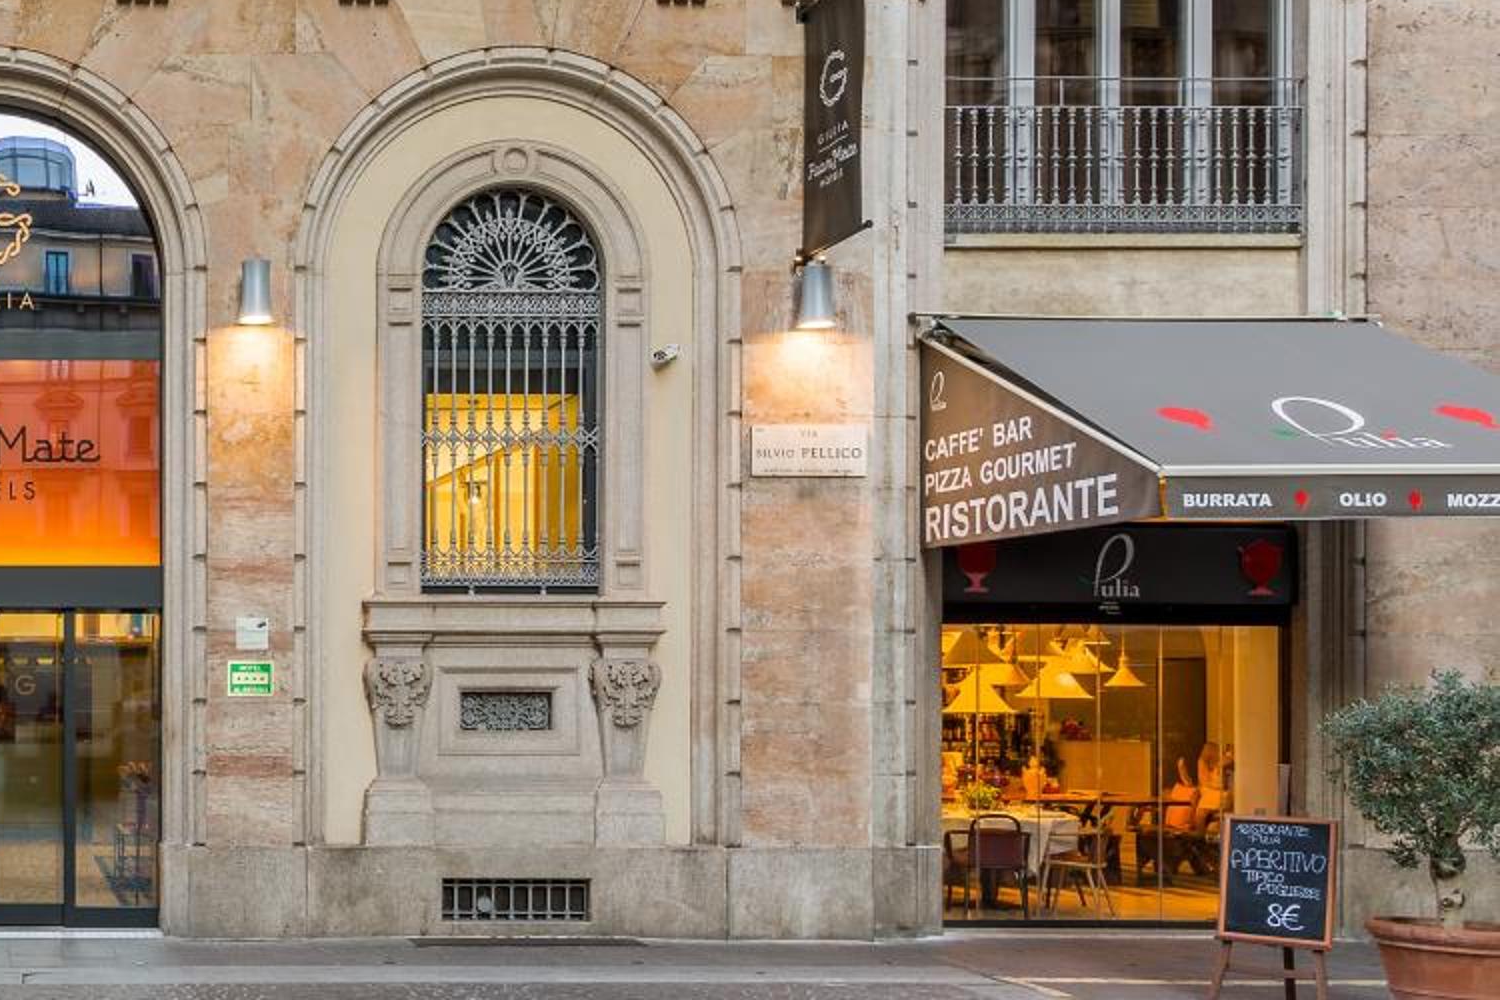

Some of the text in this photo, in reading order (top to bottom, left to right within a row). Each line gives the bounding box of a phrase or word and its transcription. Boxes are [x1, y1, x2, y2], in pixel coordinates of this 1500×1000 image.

[925, 416, 1033, 461] CAFFE' BAR
[756, 447, 863, 459] SILVIO PELLICO
[925, 442, 1076, 496] PIZZA GOURMET
[925, 474, 1119, 543] RISTORANTE
[1182, 493, 1272, 508] BURRATA
[1339, 493, 1387, 507] OLIO
[1093, 533, 1140, 597] Pulia
[1230, 847, 1327, 873] APERITIVO
[1267, 903, 1305, 931] 8€
